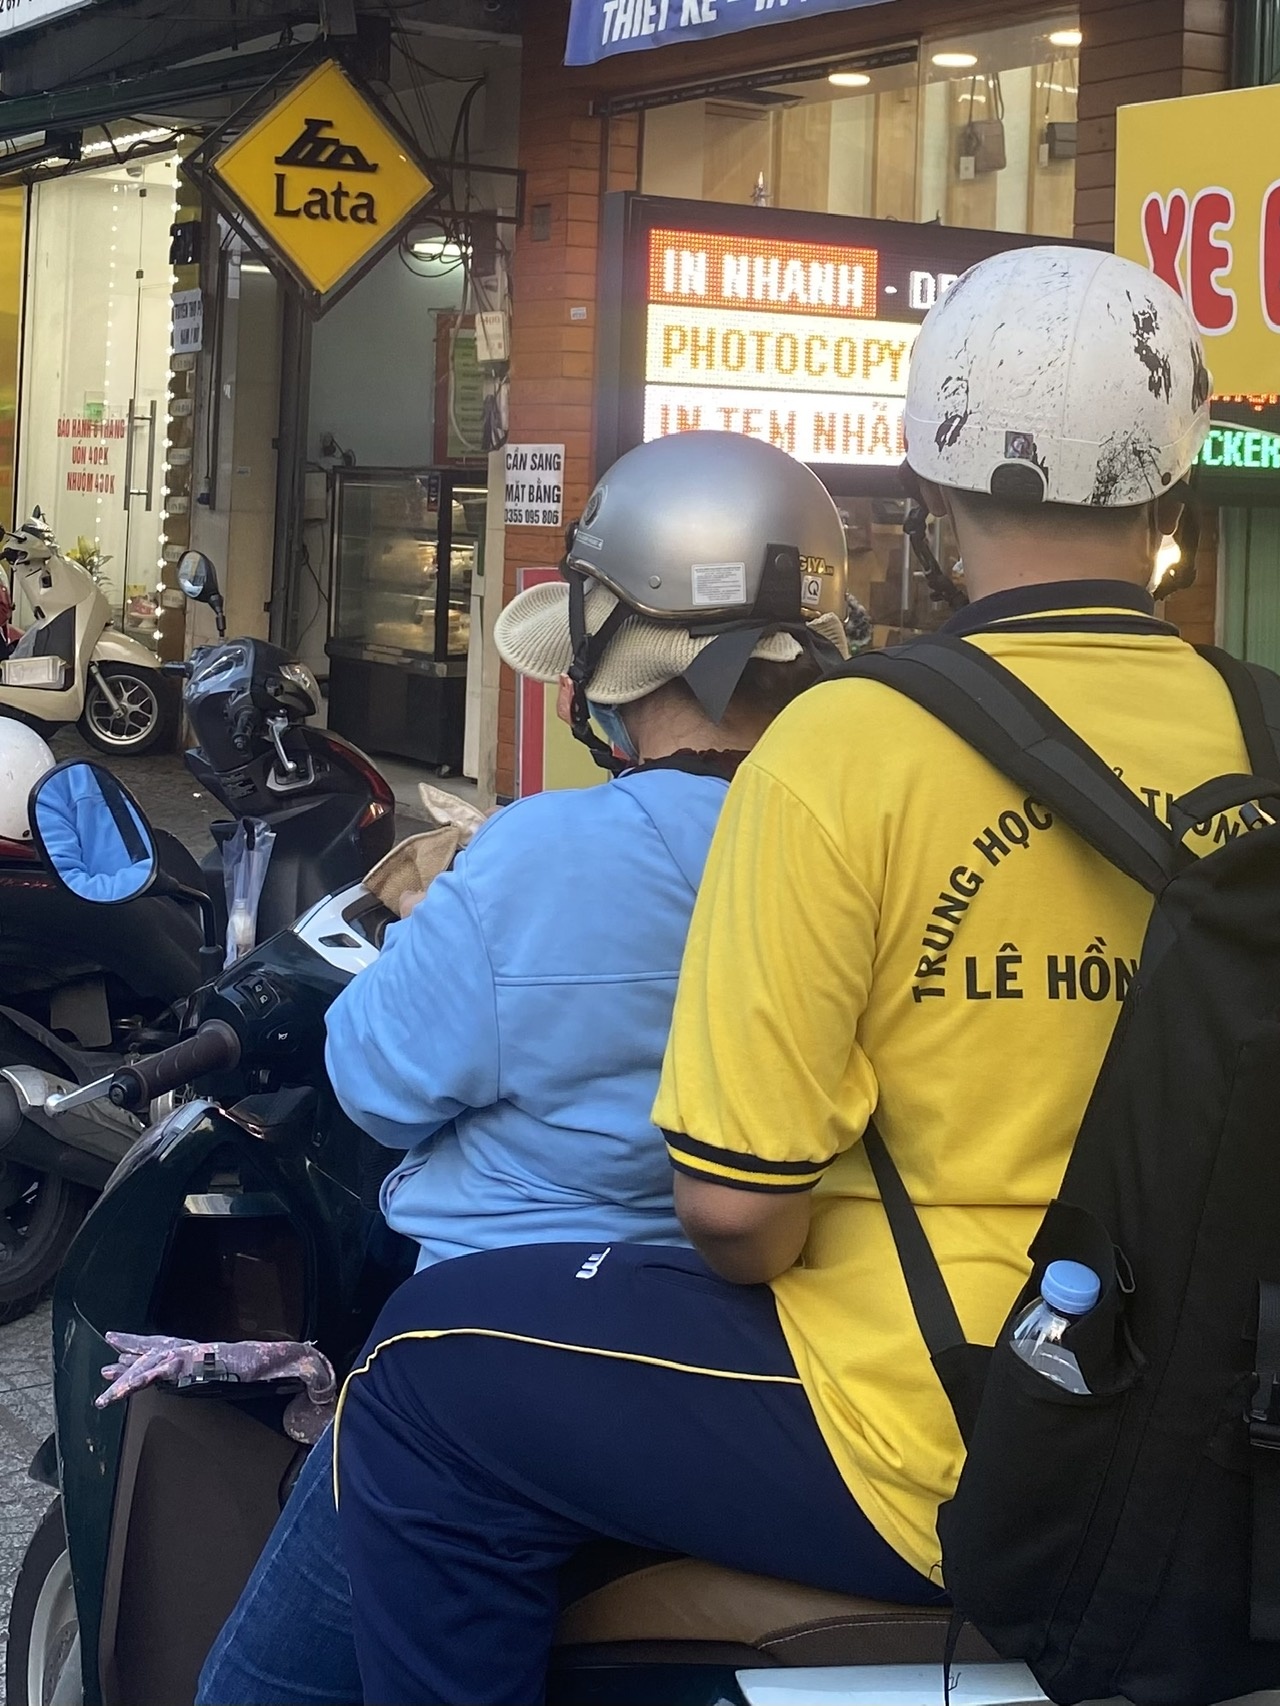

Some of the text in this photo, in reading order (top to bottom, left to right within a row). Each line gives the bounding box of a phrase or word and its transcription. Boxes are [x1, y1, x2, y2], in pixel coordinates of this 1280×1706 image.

[274, 172, 378, 225] Lata
[663, 248, 706, 296] IN
[722, 253, 864, 308] NHANH
[1142, 187, 1238, 335] XE
[662, 324, 908, 382] PHOTOCOPY
[660, 404, 702, 435] IN
[528, 477, 561, 503] BẰNG
[530, 453, 561, 471] SANG
[913, 796, 1053, 1003] TRUNG HỌC
[965, 942, 1025, 1000] LÊ
